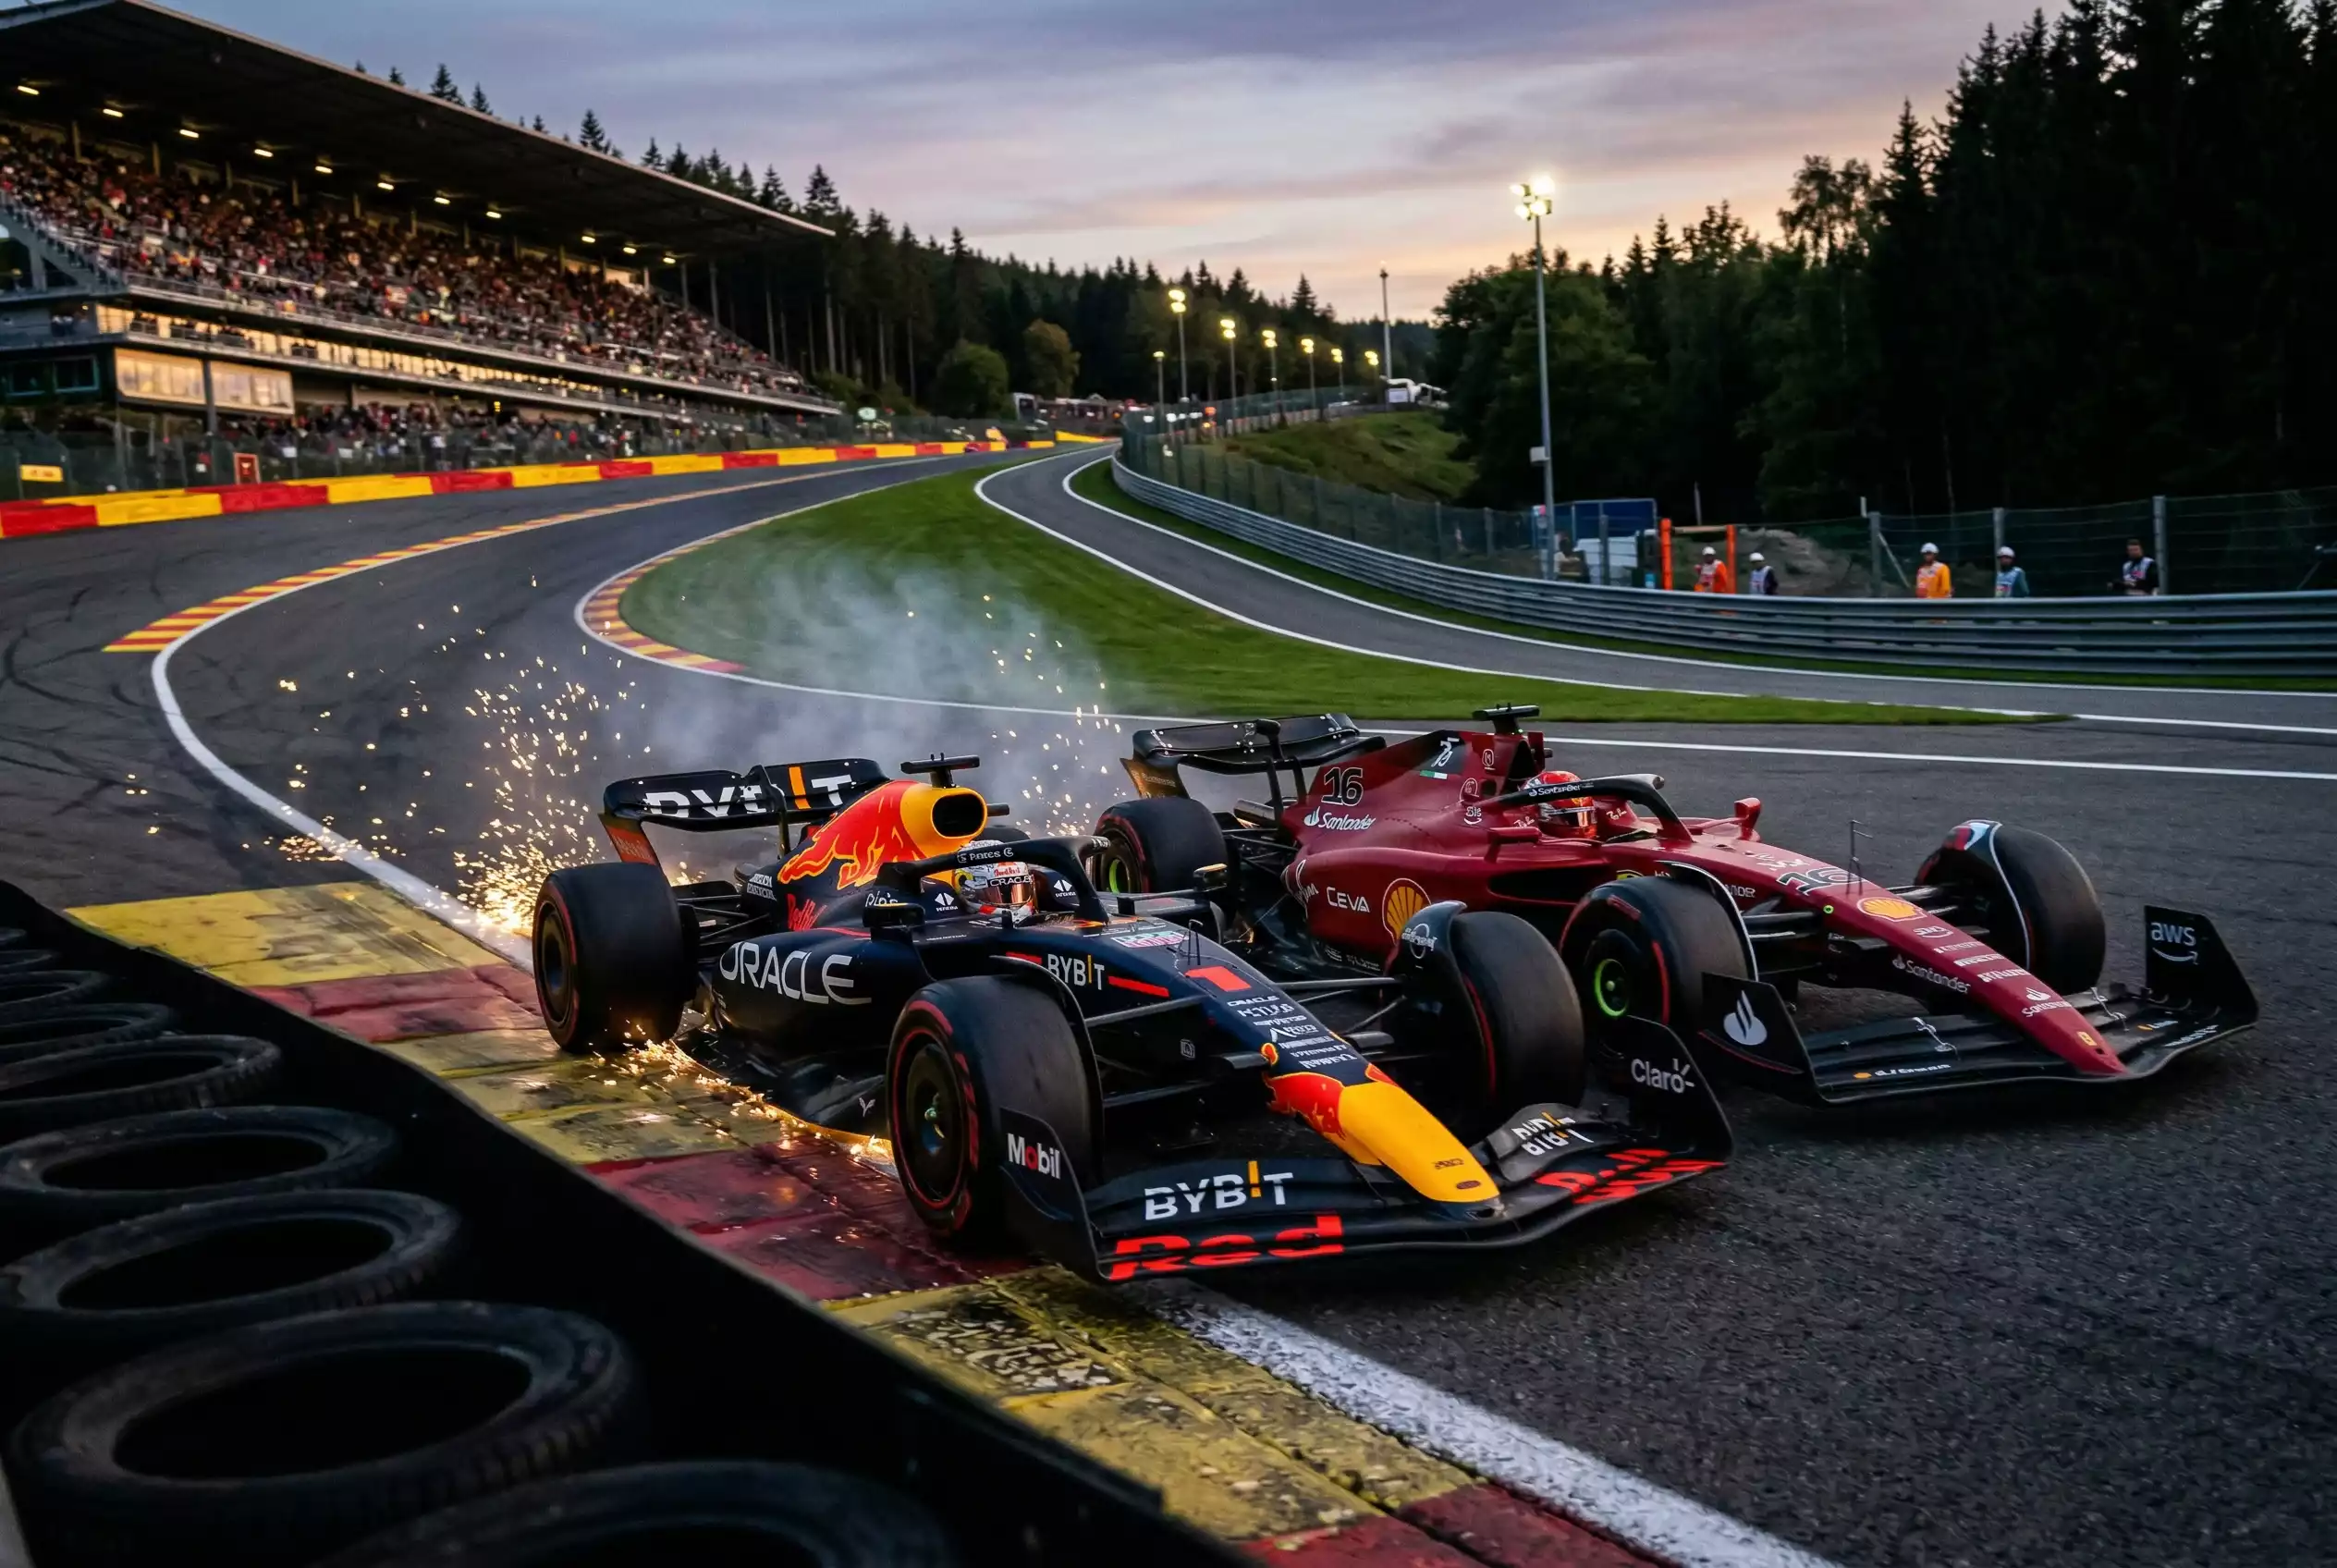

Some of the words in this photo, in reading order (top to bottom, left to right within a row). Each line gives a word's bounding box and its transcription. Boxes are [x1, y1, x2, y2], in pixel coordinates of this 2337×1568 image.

[1321, 766, 1364, 806] 16
[1327, 887, 1370, 913] CEVA
[2151, 922, 2196, 946] aws
[719, 942, 872, 1005] ORACLE
[1047, 953, 1105, 990] BYBIT
[1185, 965, 1251, 992] 1
[1631, 1058, 1690, 1093] Claro
[1007, 1133, 1060, 1179] Mobil
